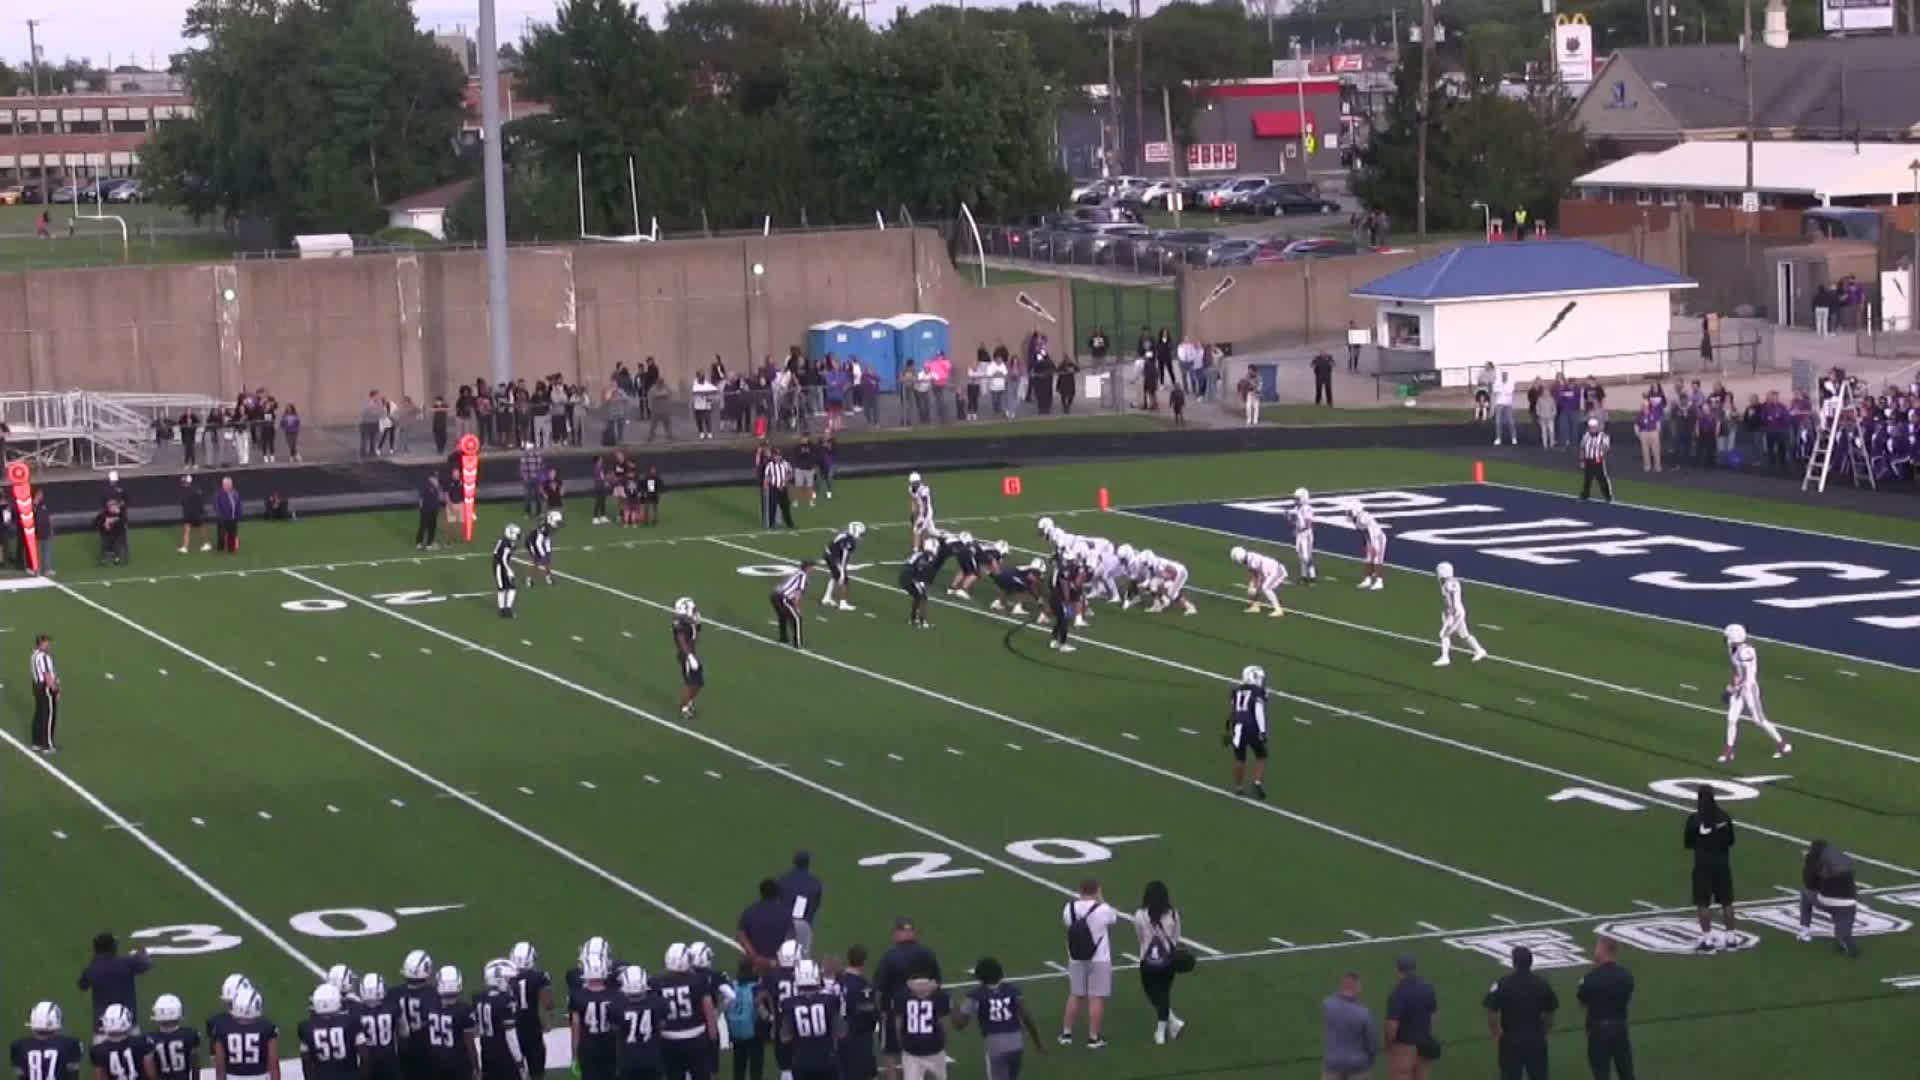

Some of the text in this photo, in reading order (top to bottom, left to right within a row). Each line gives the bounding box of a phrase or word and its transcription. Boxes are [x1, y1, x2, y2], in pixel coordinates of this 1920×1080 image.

[1224, 491, 1745, 566] BLUE
[1236, 690, 1252, 712] 17
[858, 838, 1112, 883] 20
[360, 1013, 393, 1047] 38
[427, 1013, 455, 1047] 25
[623, 1008, 653, 1043] 74
[793, 1003, 827, 1037] 60
[906, 1000, 934, 1034] 82
[155, 1040, 184, 1073] 16
[226, 1032, 261, 1064] 95
[312, 1027, 347, 1062] 59
[27, 1049, 59, 1080] 87
[108, 1047, 139, 1080] 41
